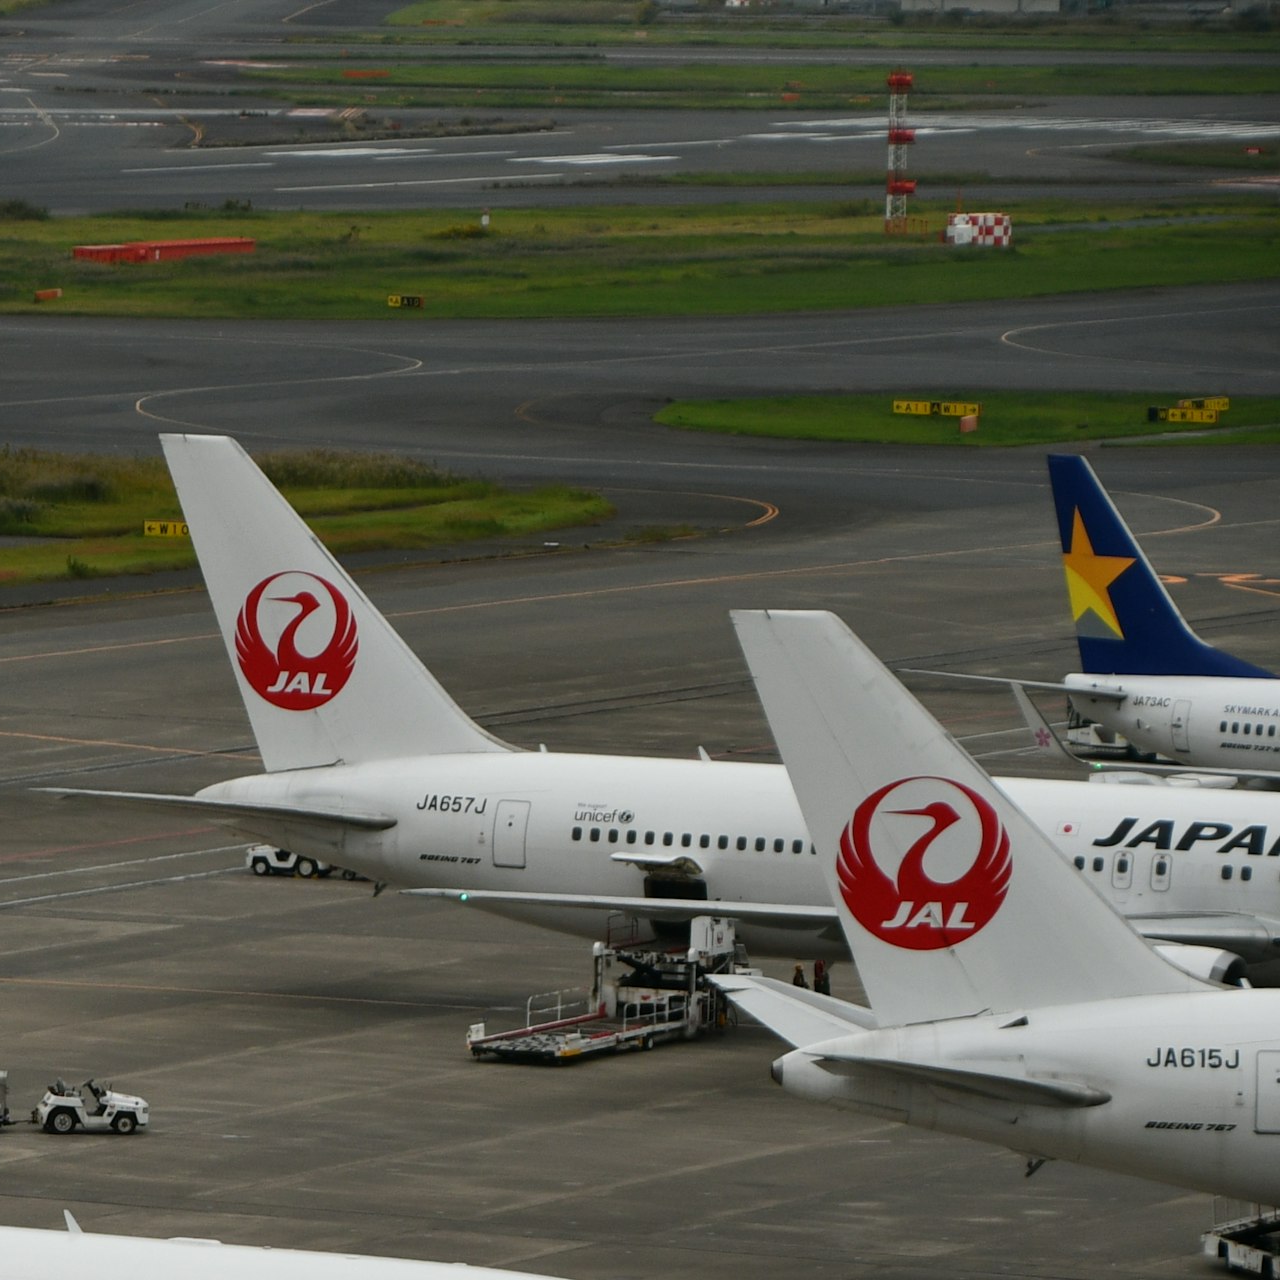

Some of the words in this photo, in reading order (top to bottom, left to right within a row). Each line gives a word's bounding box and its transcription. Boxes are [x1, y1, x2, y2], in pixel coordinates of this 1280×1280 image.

[266, 670, 333, 695] JAL
[1224, 704, 1271, 717] SKYMARK
[416, 794, 488, 814] JA657J
[574, 808, 618, 823] unicef
[1092, 817, 1280, 857] JAPA
[880, 900, 976, 929] JAL
[1146, 1047, 1239, 1069] JA615J
[1144, 1121, 1204, 1131] BOEING
[1205, 1123, 1238, 1132] 767
